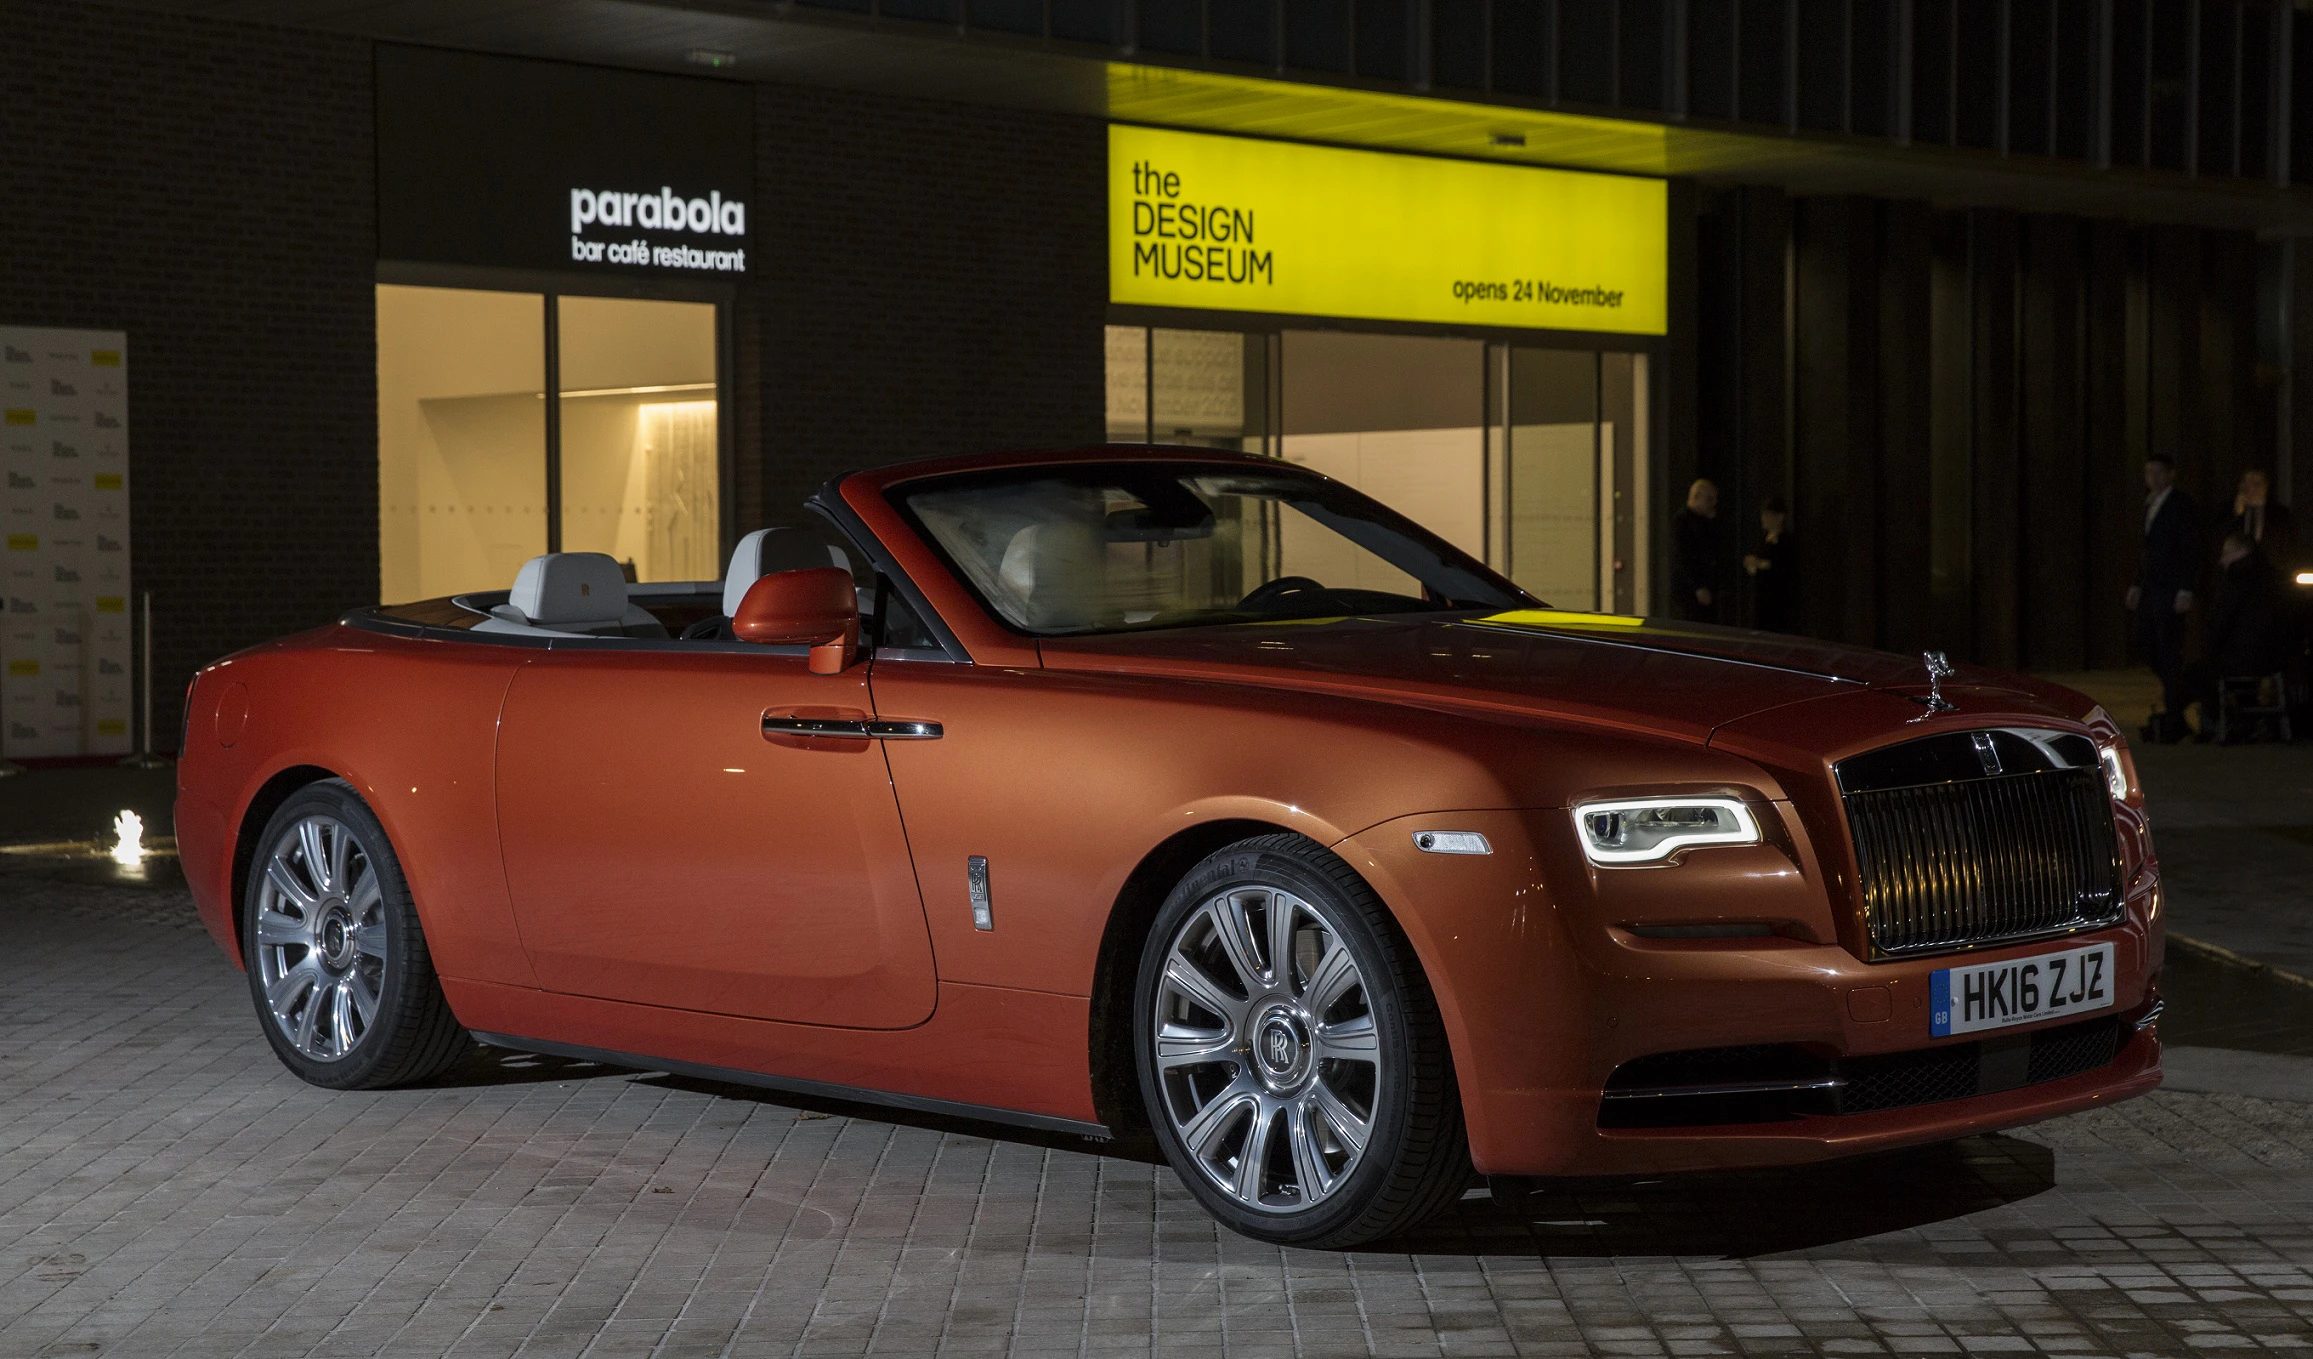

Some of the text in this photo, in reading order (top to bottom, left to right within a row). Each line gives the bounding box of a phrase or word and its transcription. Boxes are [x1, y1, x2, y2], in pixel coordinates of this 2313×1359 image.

[1133, 160, 1180, 198] the
[571, 186, 745, 235] parabola
[1134, 201, 1253, 244] DESIGN
[572, 235, 746, 272] bar café restaurant
[1134, 241, 1272, 285] MUSEUM
[1453, 279, 1624, 308] opens 24 November
[1964, 951, 2104, 1022] HK16 ZJZ
[1935, 1011, 1948, 1025] GB
